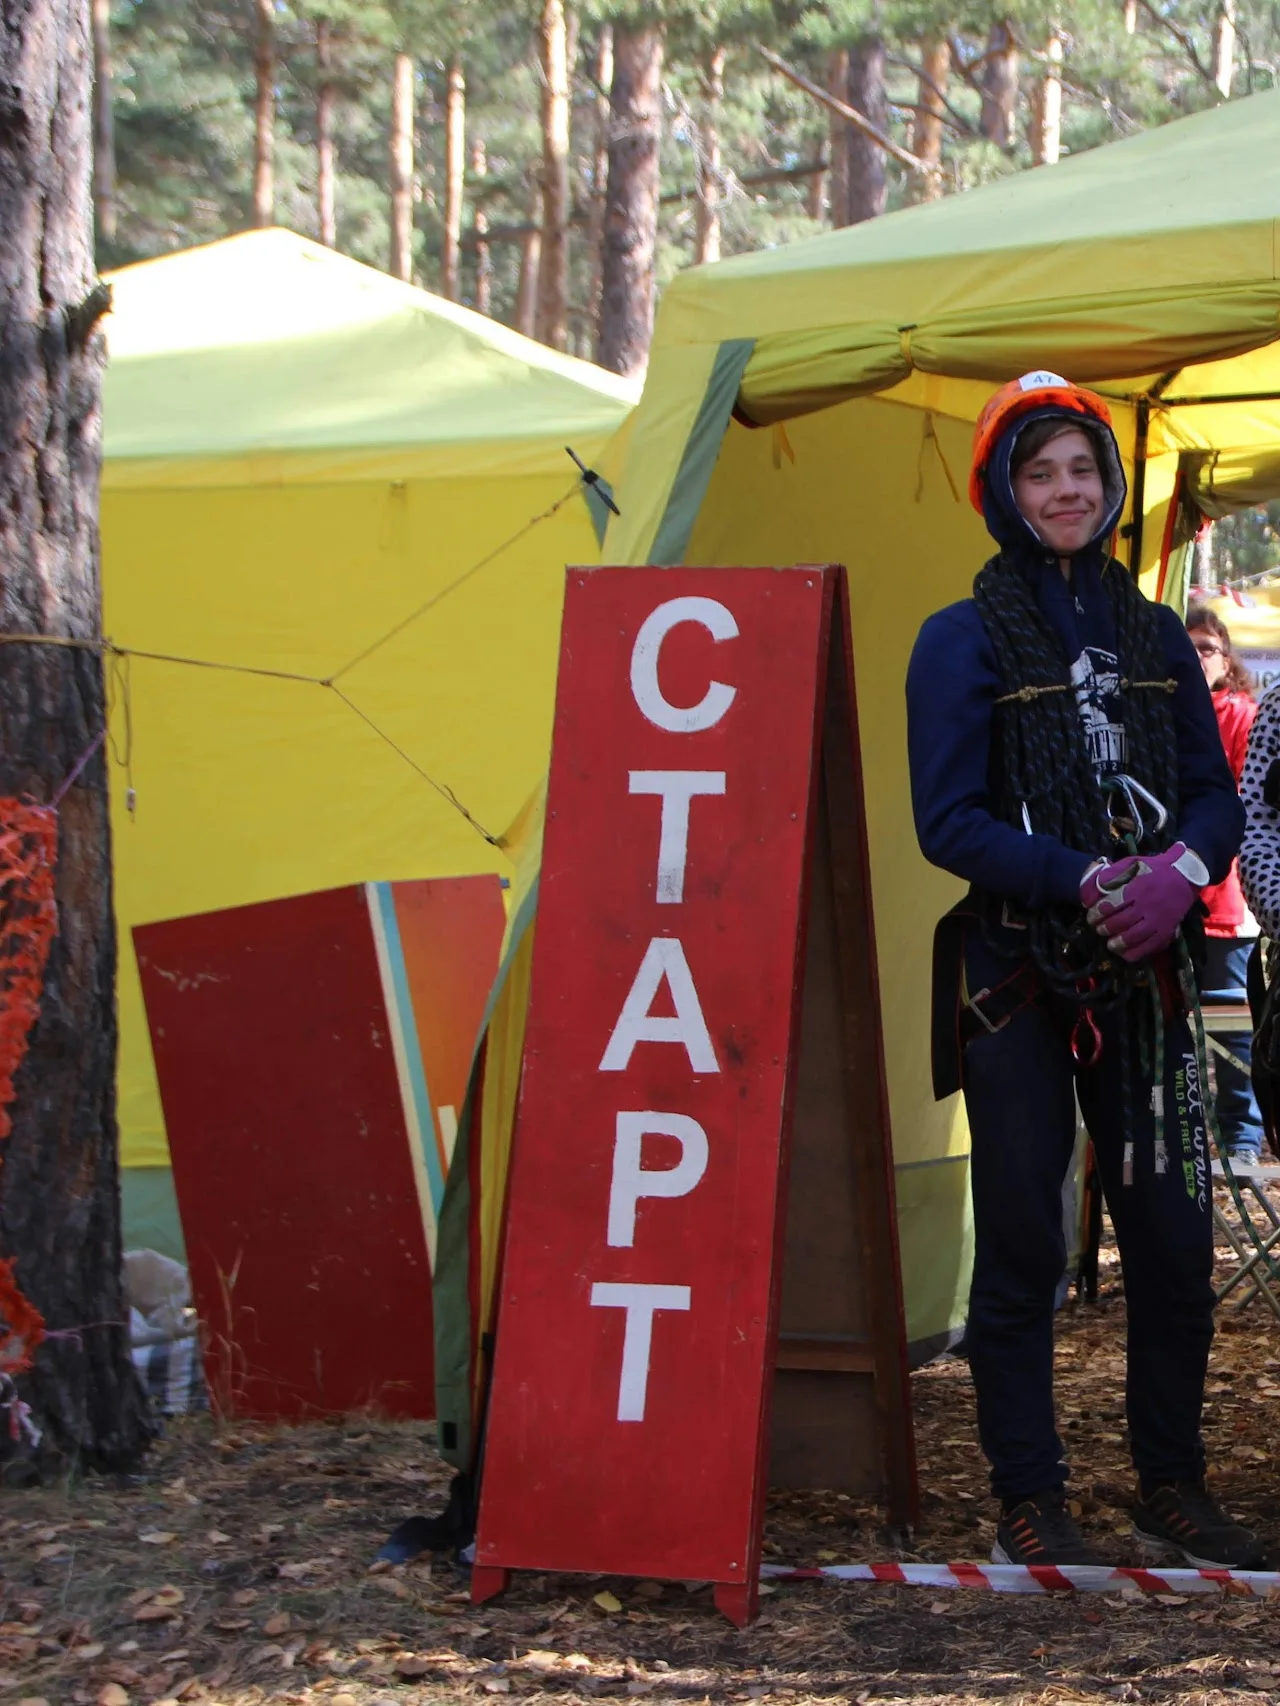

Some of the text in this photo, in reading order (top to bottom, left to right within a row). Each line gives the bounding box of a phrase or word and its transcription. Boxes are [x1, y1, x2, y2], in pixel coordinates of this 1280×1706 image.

[590, 595, 740, 1423] СТАРТ
[1175, 1069, 1185, 1100] WILD
[1178, 1106, 1187, 1115] &
[1180, 1120, 1191, 1153] FREE
[1182, 1053, 1206, 1212] next wave
